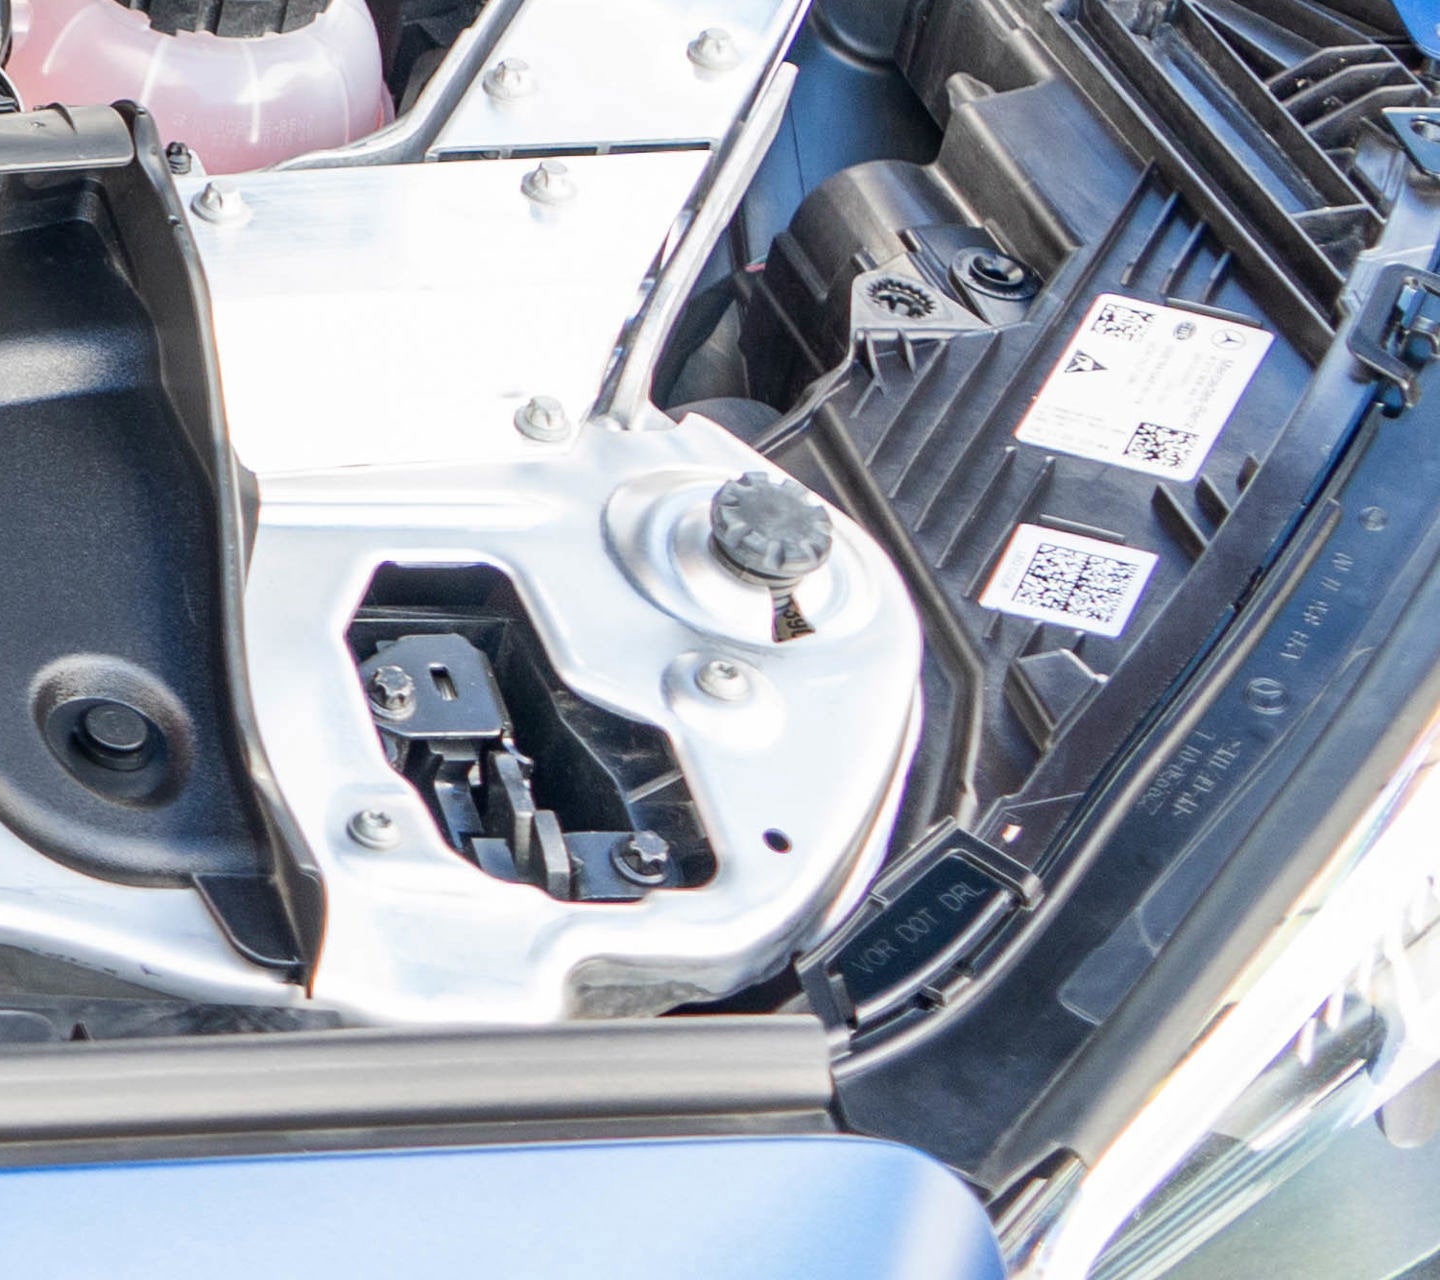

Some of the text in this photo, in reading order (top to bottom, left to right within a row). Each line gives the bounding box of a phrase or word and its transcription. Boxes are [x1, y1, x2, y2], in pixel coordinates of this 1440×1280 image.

[854, 881, 989, 975] VOR DOT DRL
